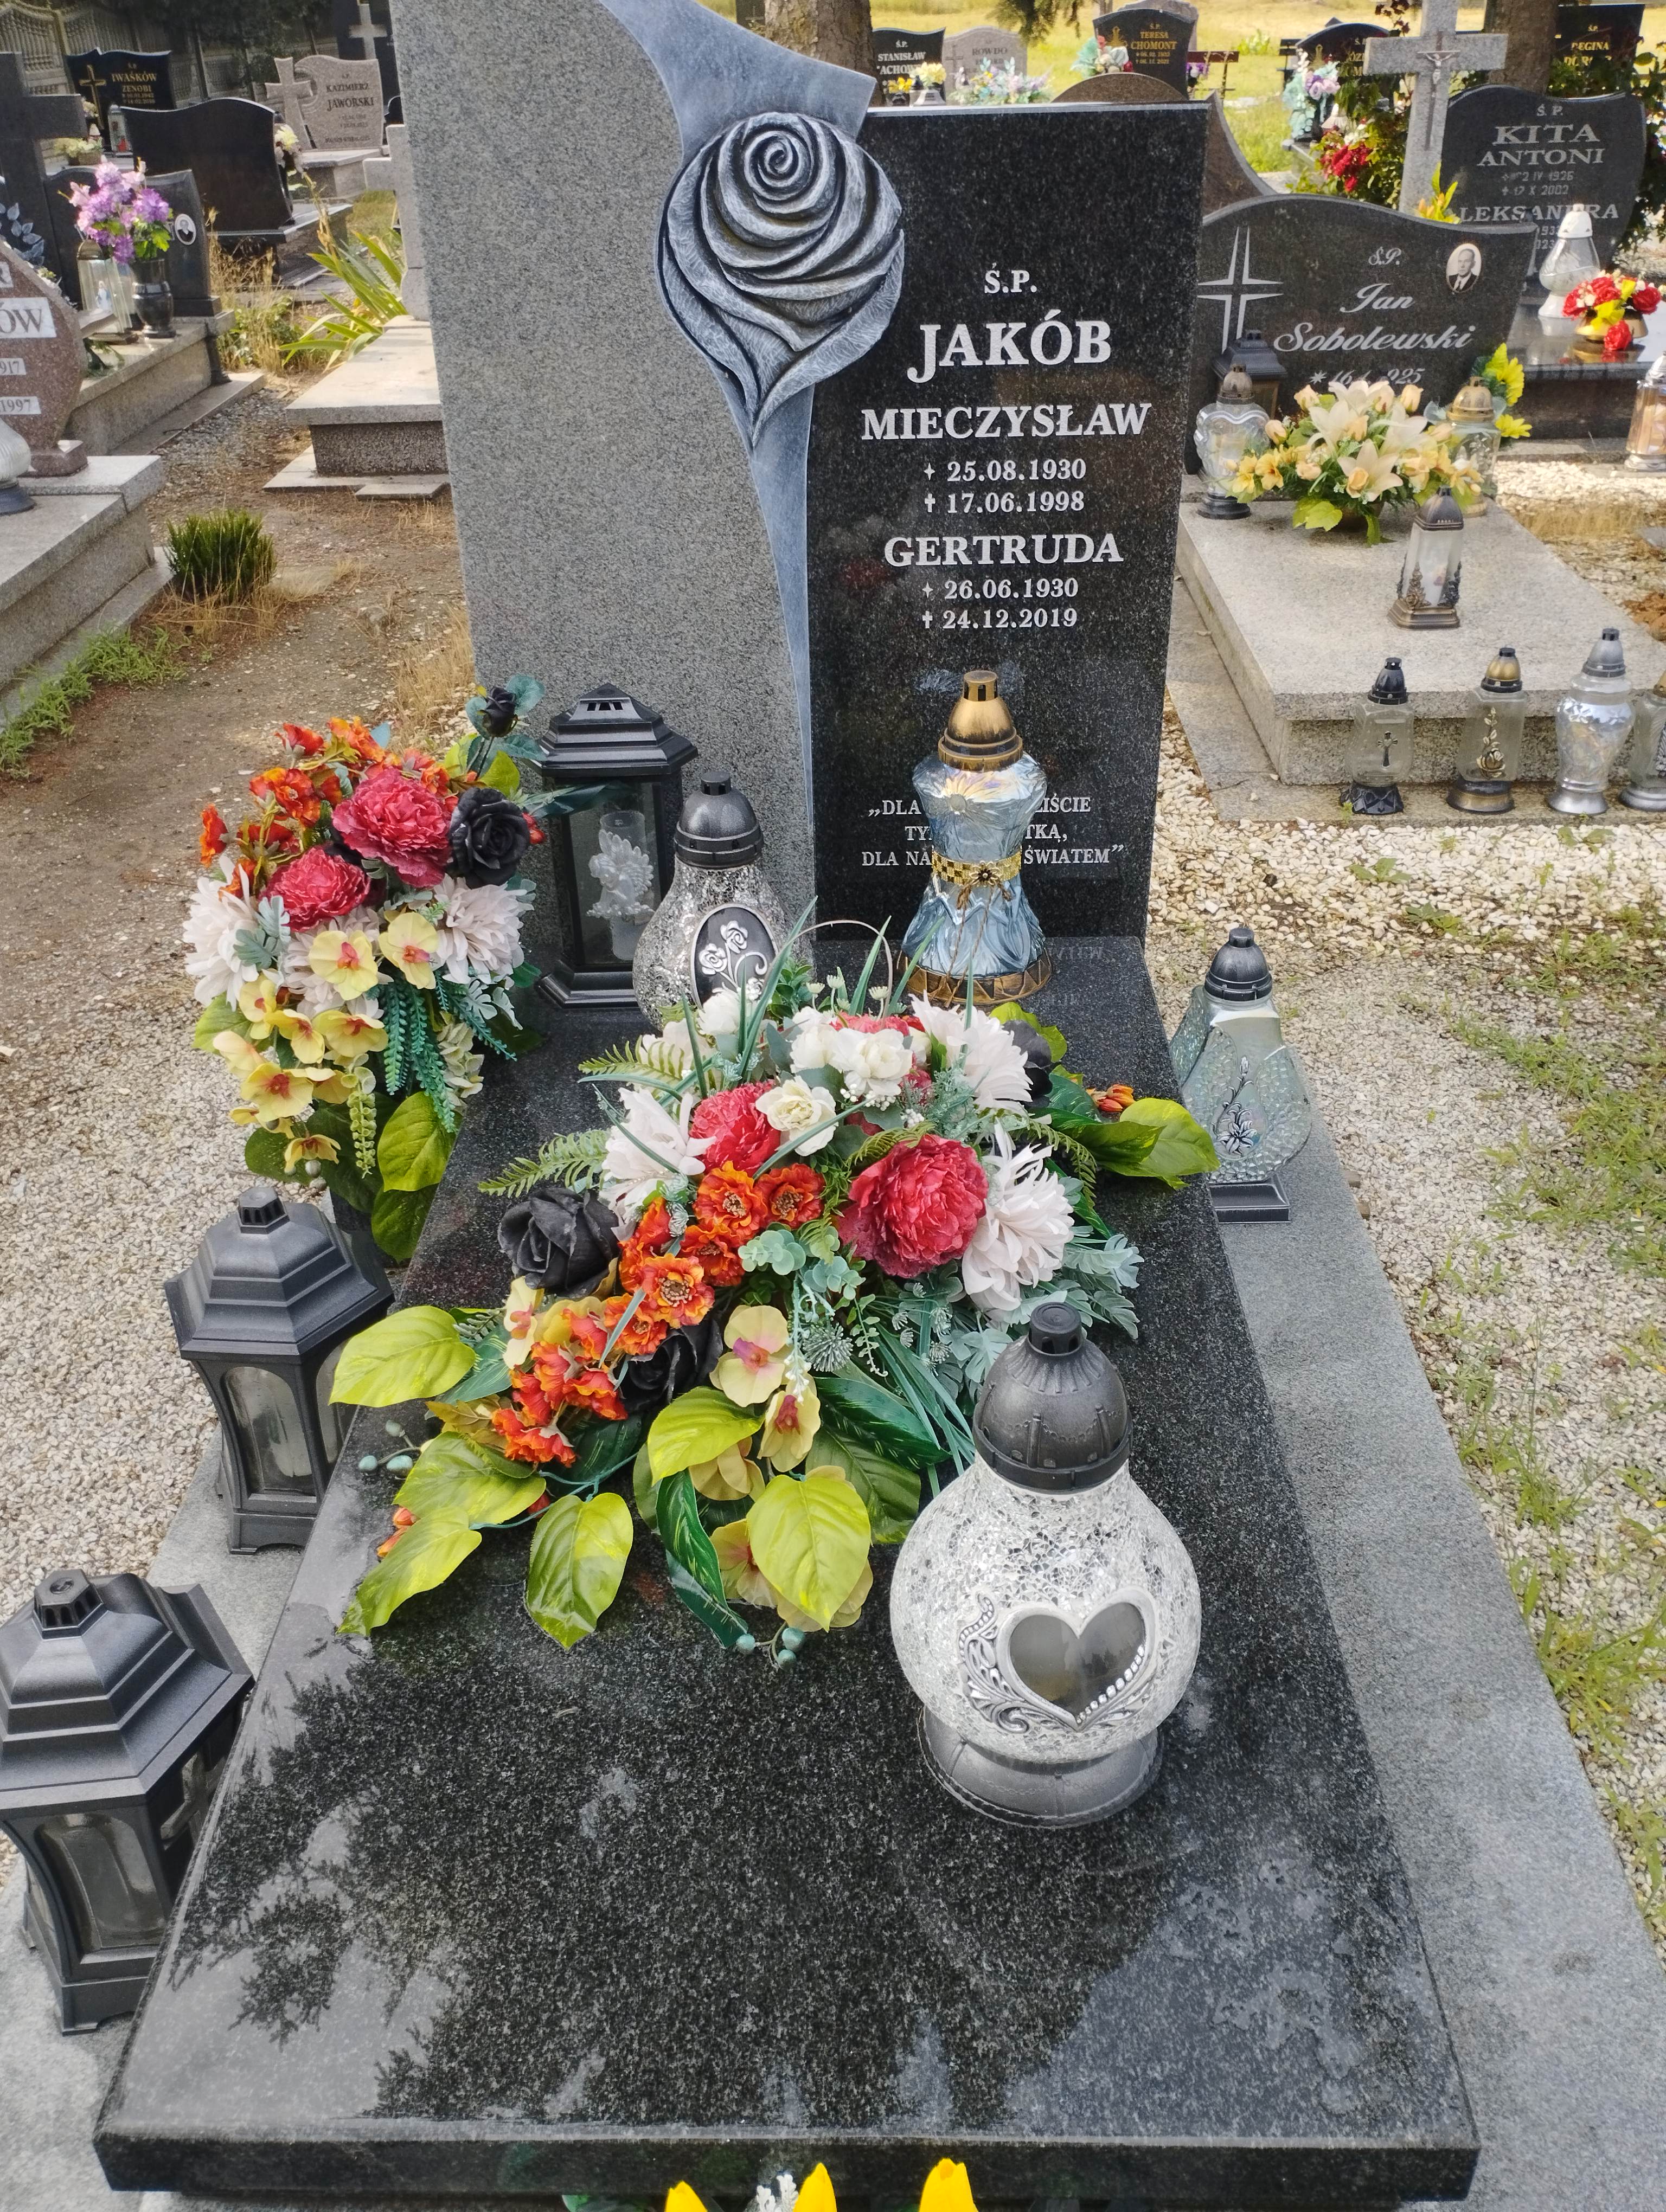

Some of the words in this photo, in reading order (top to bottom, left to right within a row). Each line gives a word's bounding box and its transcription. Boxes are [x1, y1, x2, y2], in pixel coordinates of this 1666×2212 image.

[877, 52, 926, 61] STANISŁAW
[1130, 41, 1177, 50] CHOMONT
[326, 83, 369, 93] KAZIMIERZ
[327, 97, 374, 112] JAWORSKI
[1492, 124, 1600, 146] KITA
[1476, 148, 1606, 167] ANTONI
[1459, 204, 1619, 222] LEKSANRA
[984, 262, 1037, 294] Ś.P.
[1340, 283, 1414, 313] Jan
[0, 302, 42, 333] ÓW
[907, 309, 1112, 383] JAKÓB
[1273, 322, 1476, 352] Sobolewski
[0, 360, 20, 374] 917
[861, 403, 1152, 440] MIECZYSŁAW
[947, 458, 1086, 482] 25.08.1930
[947, 491, 1085, 513] 17.06.1998
[884, 533, 1124, 567] GERTRUDA
[944, 577, 1079, 599] 26.06.1930
[943, 608, 1078, 629] 24.12.2019
[905, 826, 932, 841] TY
[1025, 824, 1067, 843] TKĄ,
[862, 851, 899, 866] DLA
[906, 851, 932, 865] NA
